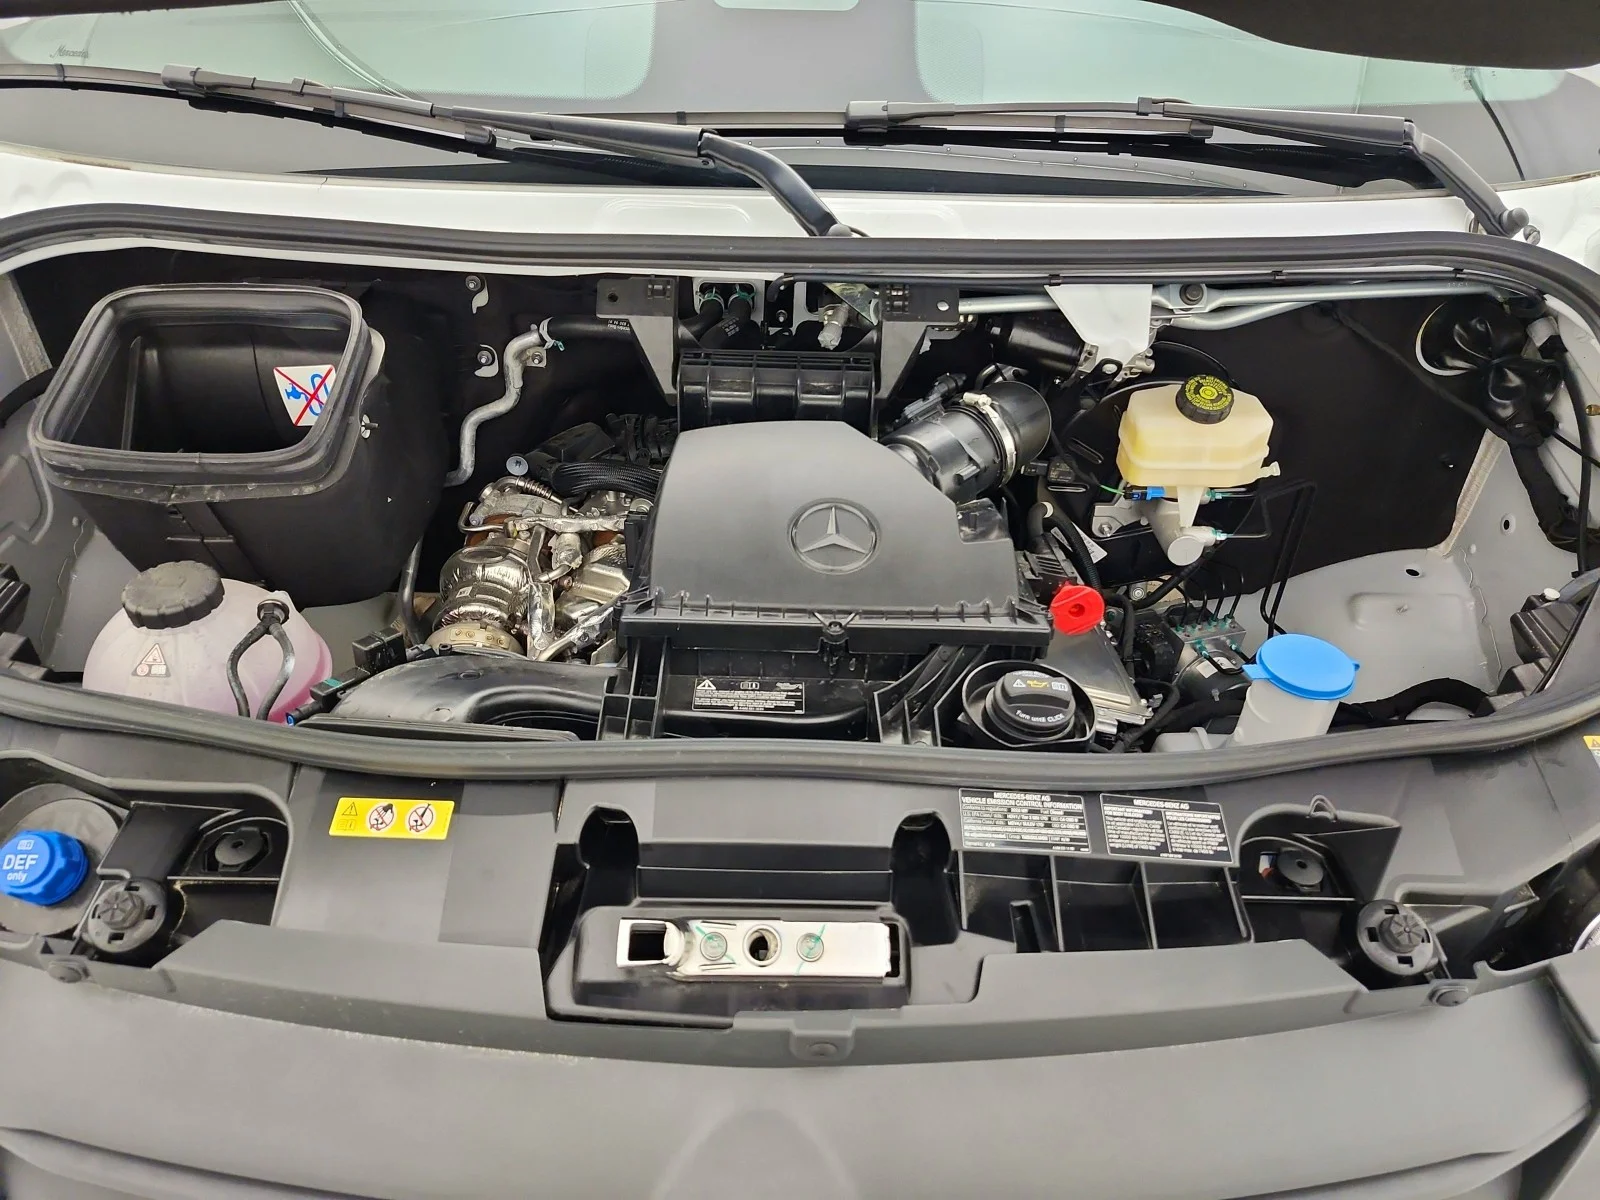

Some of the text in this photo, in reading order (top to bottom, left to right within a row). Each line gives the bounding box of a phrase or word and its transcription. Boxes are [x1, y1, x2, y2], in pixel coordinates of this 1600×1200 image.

[1015, 710, 1065, 723] Turn until CLICK
[993, 792, 1040, 800] MERCEDES-BENZ
[1043, 801, 1082, 809] INFORMATION
[1133, 799, 1179, 808] MERCEDES-BENZ
[2, 854, 39, 870] DEF
[7, 872, 27, 883] only
